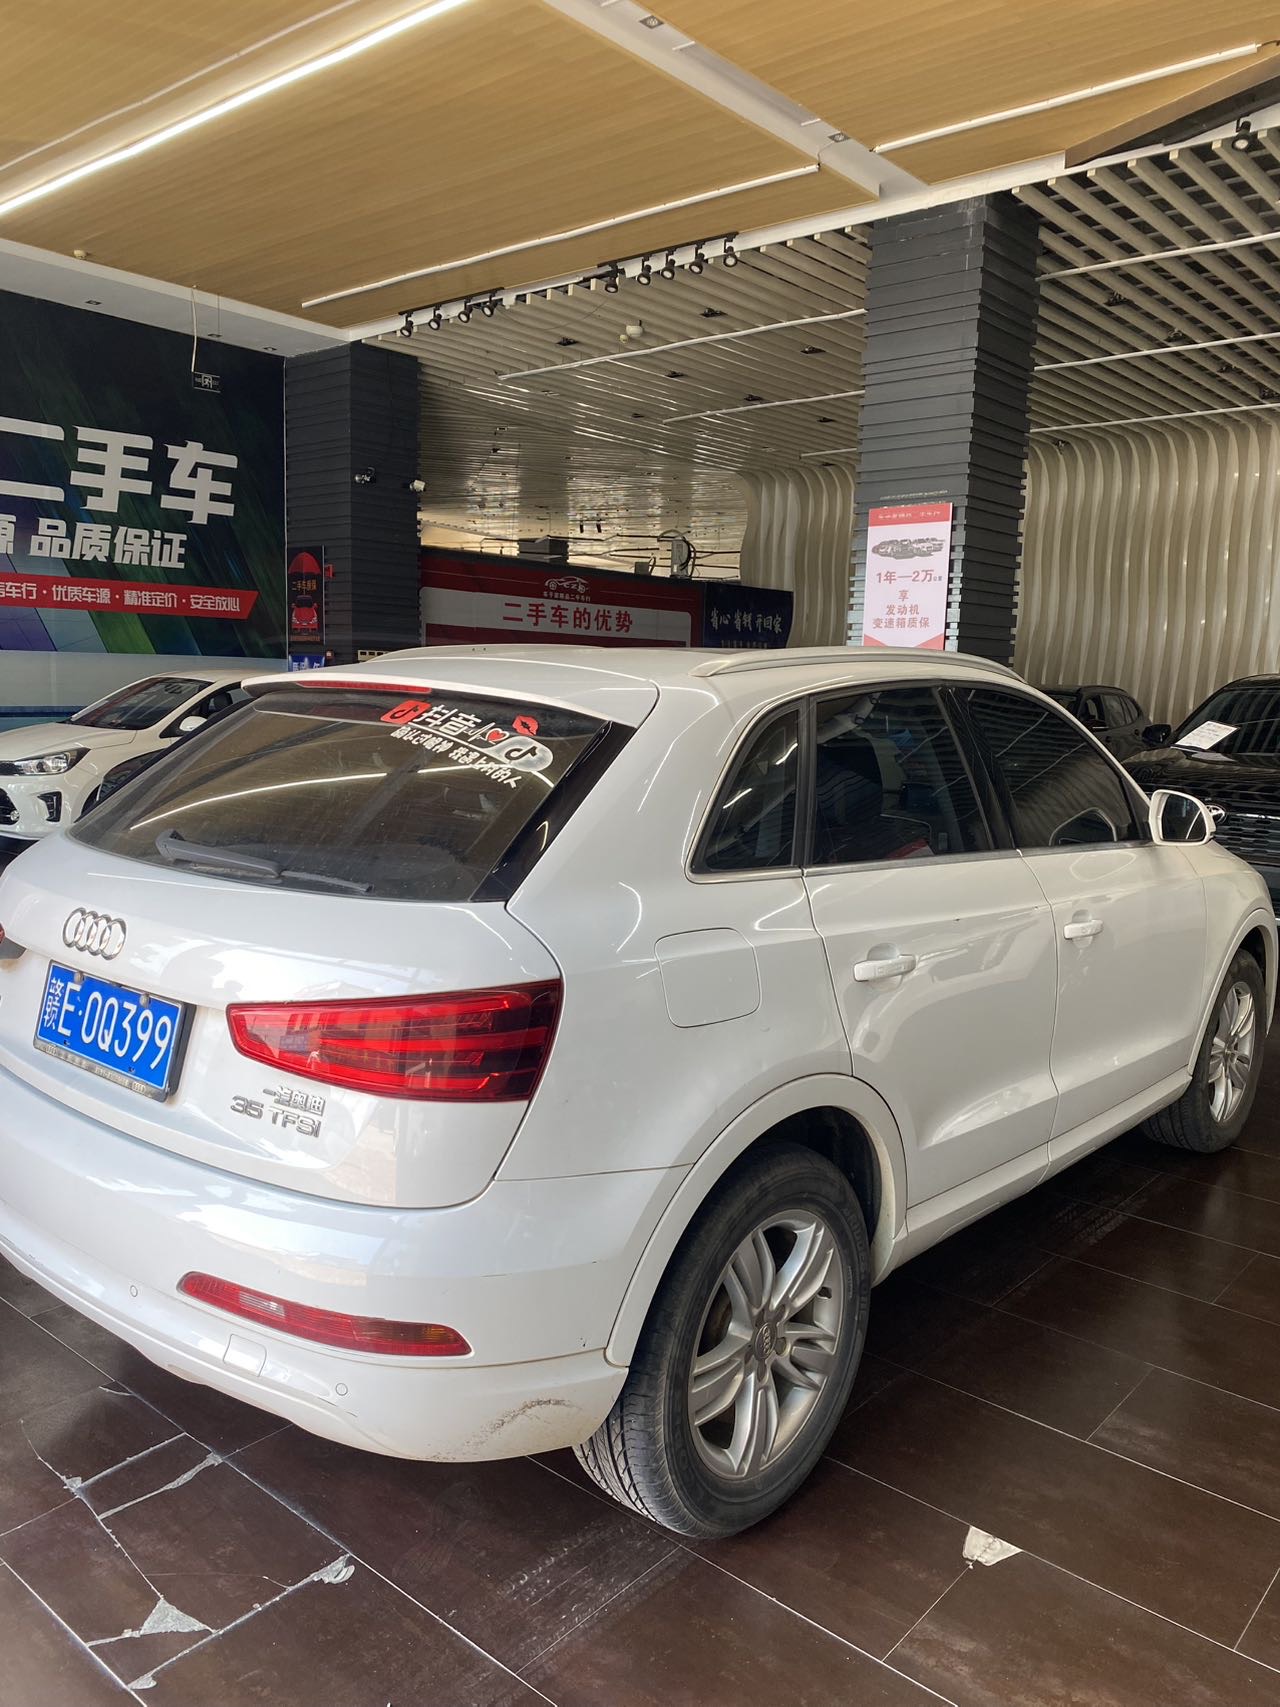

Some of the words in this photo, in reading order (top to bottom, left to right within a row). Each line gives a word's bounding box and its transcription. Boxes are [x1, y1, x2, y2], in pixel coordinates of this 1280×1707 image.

[28, 517, 187, 569] 品质保证
[886, 604, 919, 615] 发动机
[898, 589, 909, 601] 享
[503, 602, 632, 633] 二手车的优势
[873, 617, 930, 629] 变速箱质保
[413, 704, 482, 736] 抖音
[230, 1095, 264, 1119] 35
[268, 1105, 321, 1138] TFSI
[262, 1085, 325, 1117] 一汽奥迪
